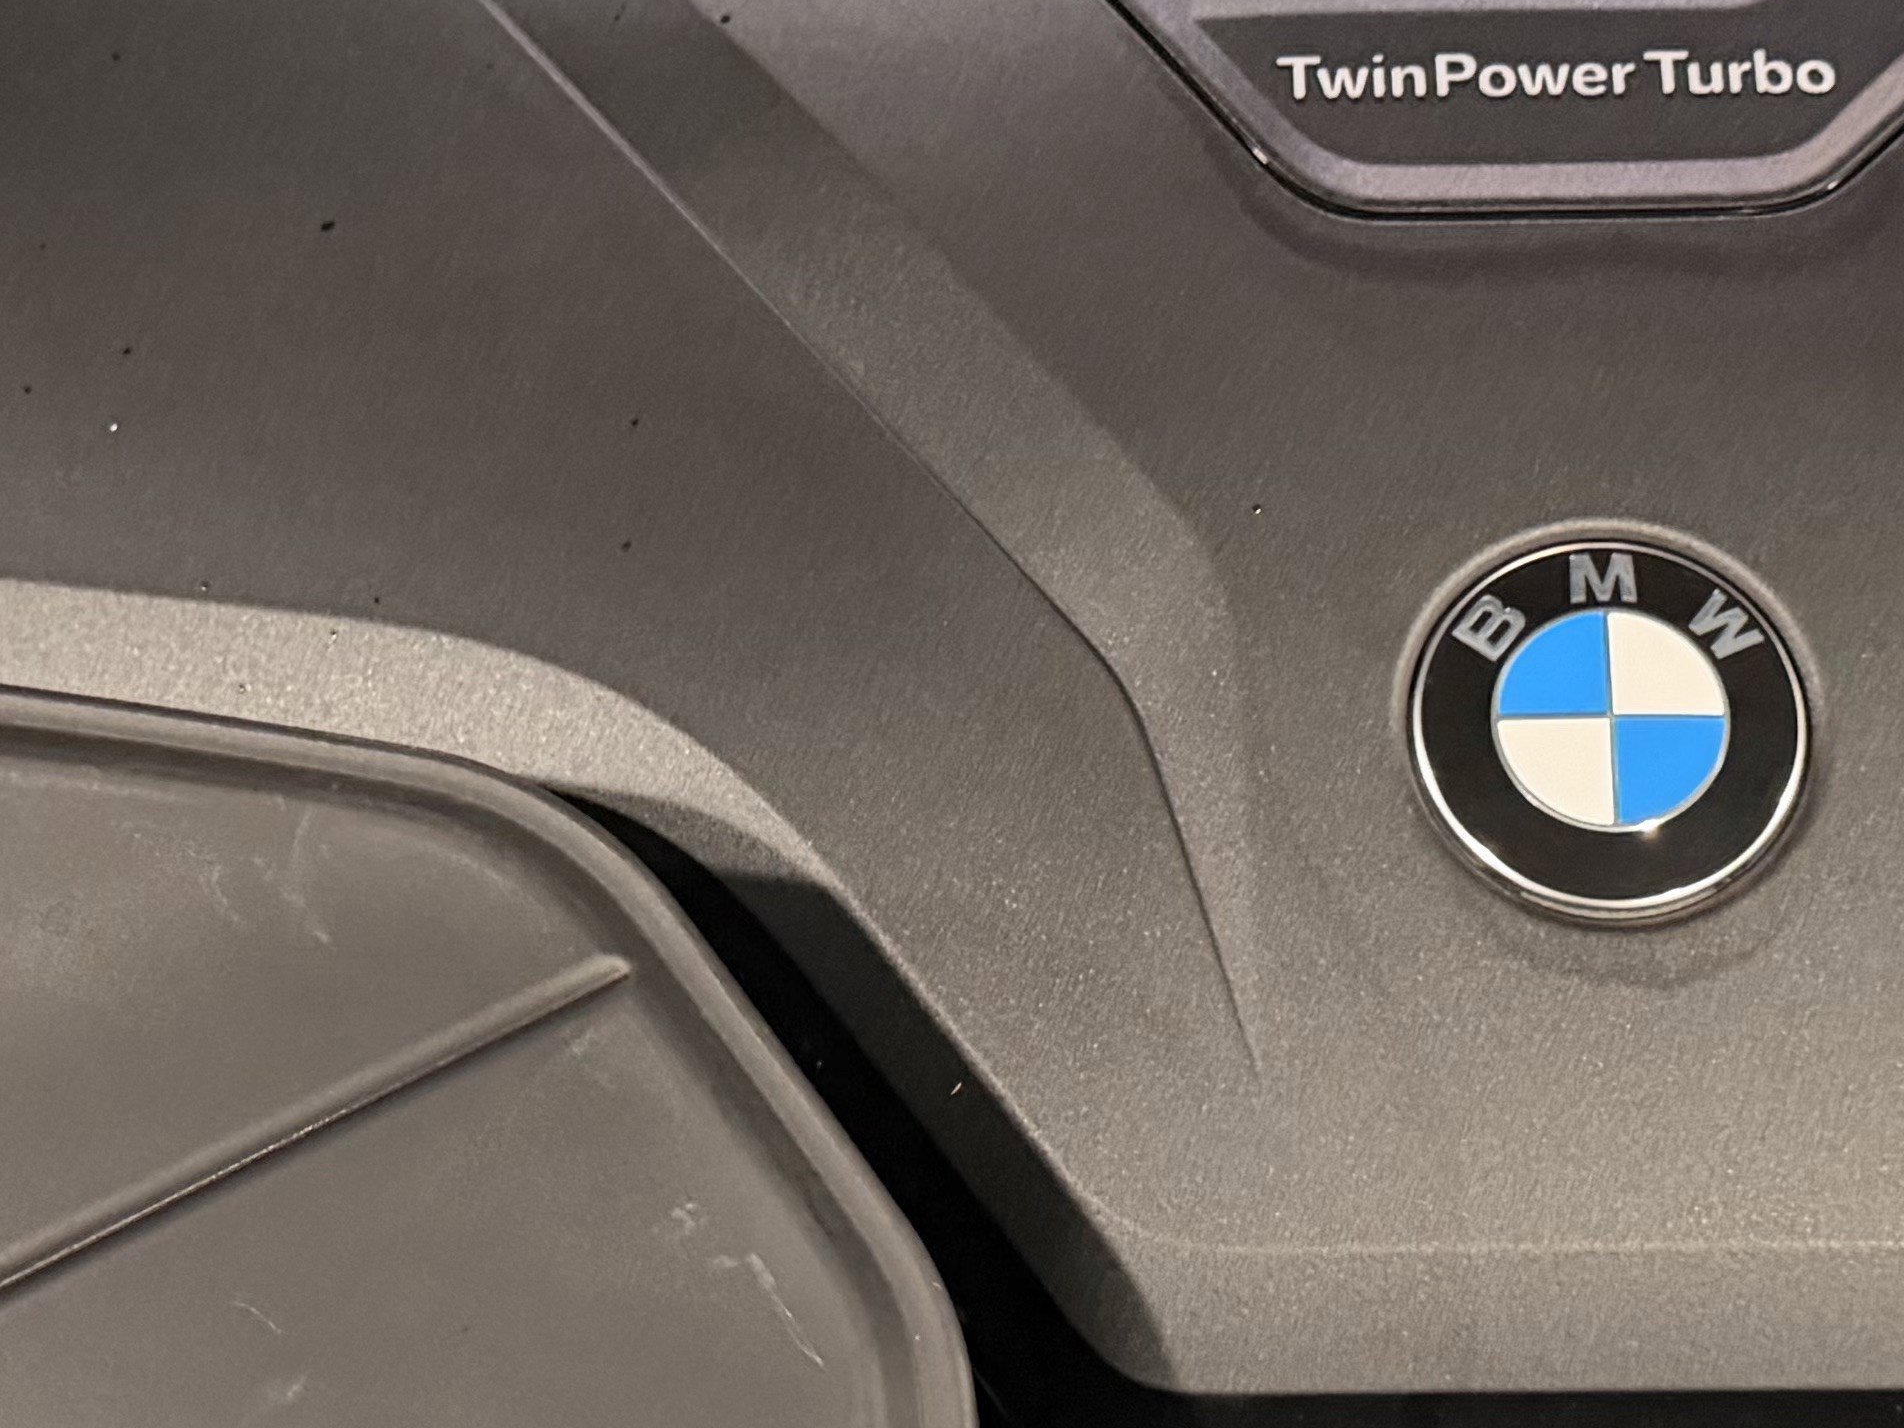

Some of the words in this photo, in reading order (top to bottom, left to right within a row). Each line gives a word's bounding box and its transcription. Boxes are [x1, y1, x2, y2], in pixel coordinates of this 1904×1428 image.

[1276, 51, 1635, 100] TwinPower
[1642, 48, 1837, 96] Turbo
[1451, 551, 1765, 662] BMW
